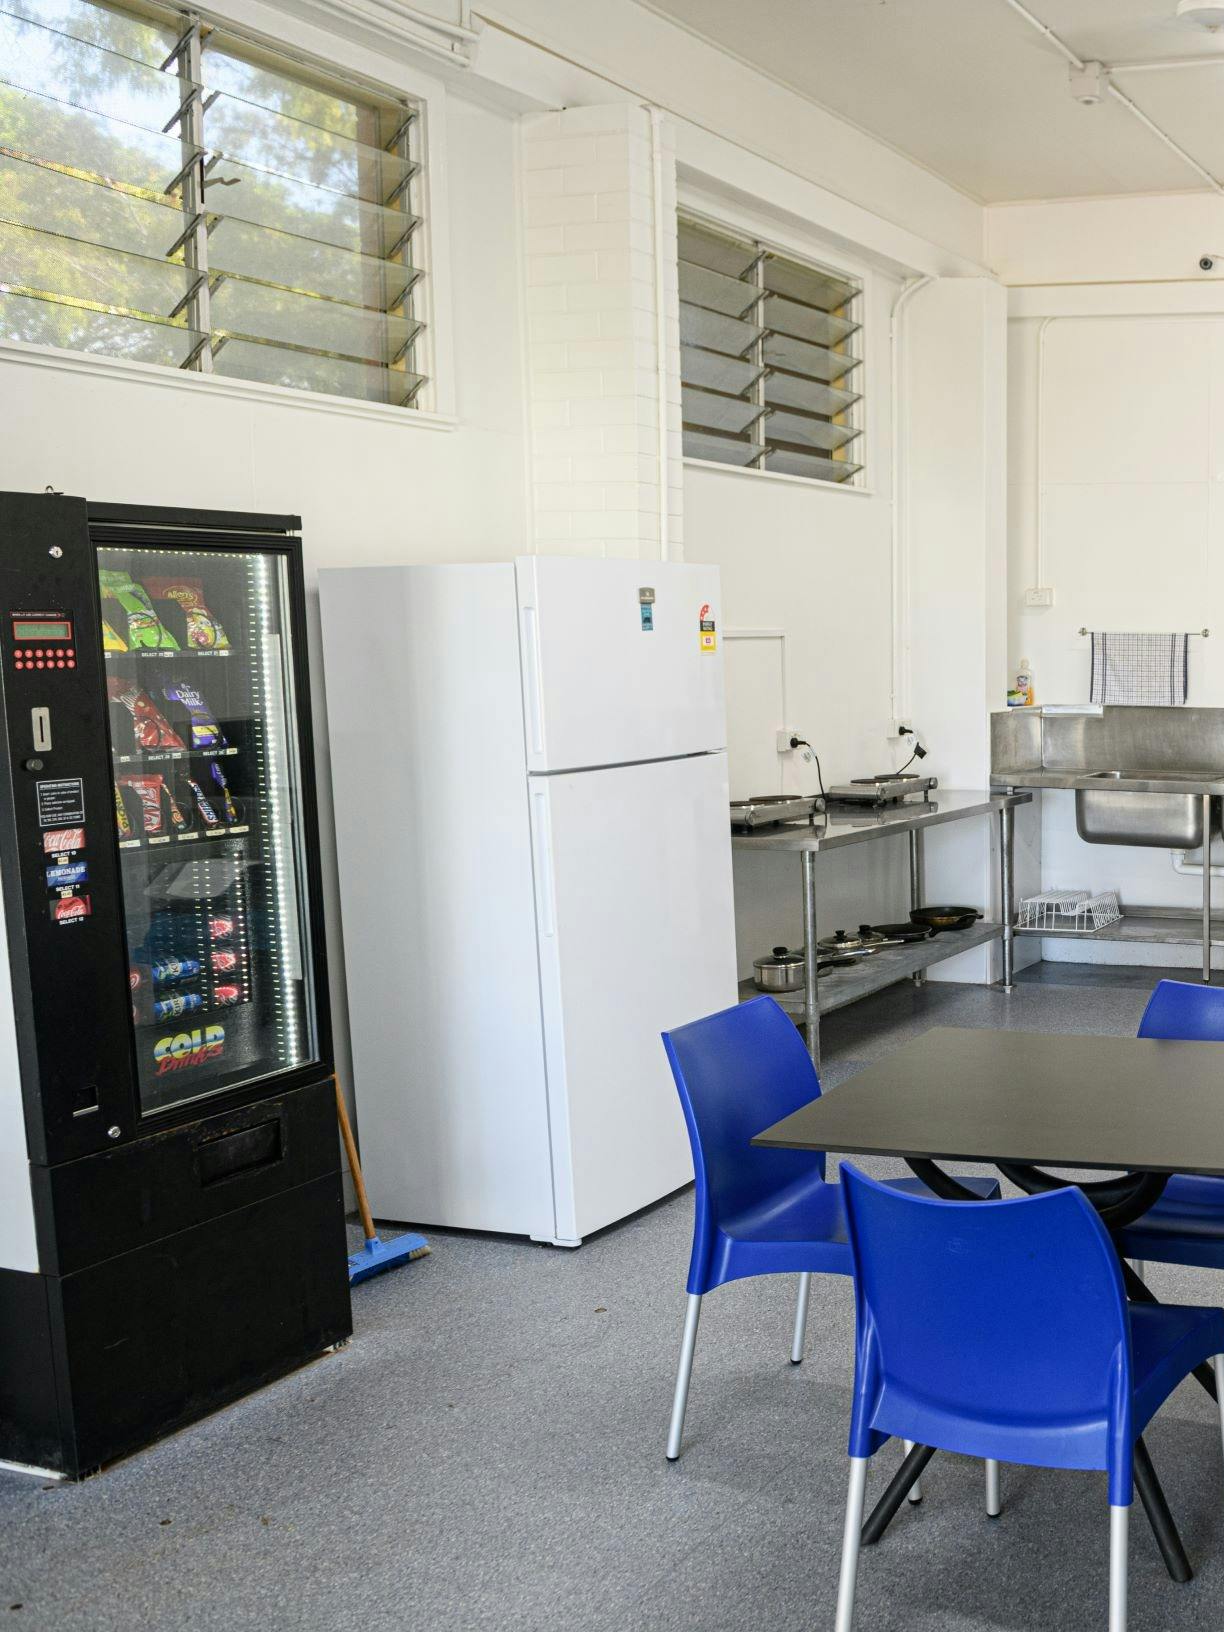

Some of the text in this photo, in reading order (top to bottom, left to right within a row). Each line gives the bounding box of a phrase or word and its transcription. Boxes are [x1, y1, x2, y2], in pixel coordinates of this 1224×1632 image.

[175, 688, 200, 701] Dairy
[46, 866, 86, 878] LEMONADE
[55, 884, 75, 892] SELECT
[59, 917, 78, 925] SELECT
[154, 1025, 226, 1062] COLD
